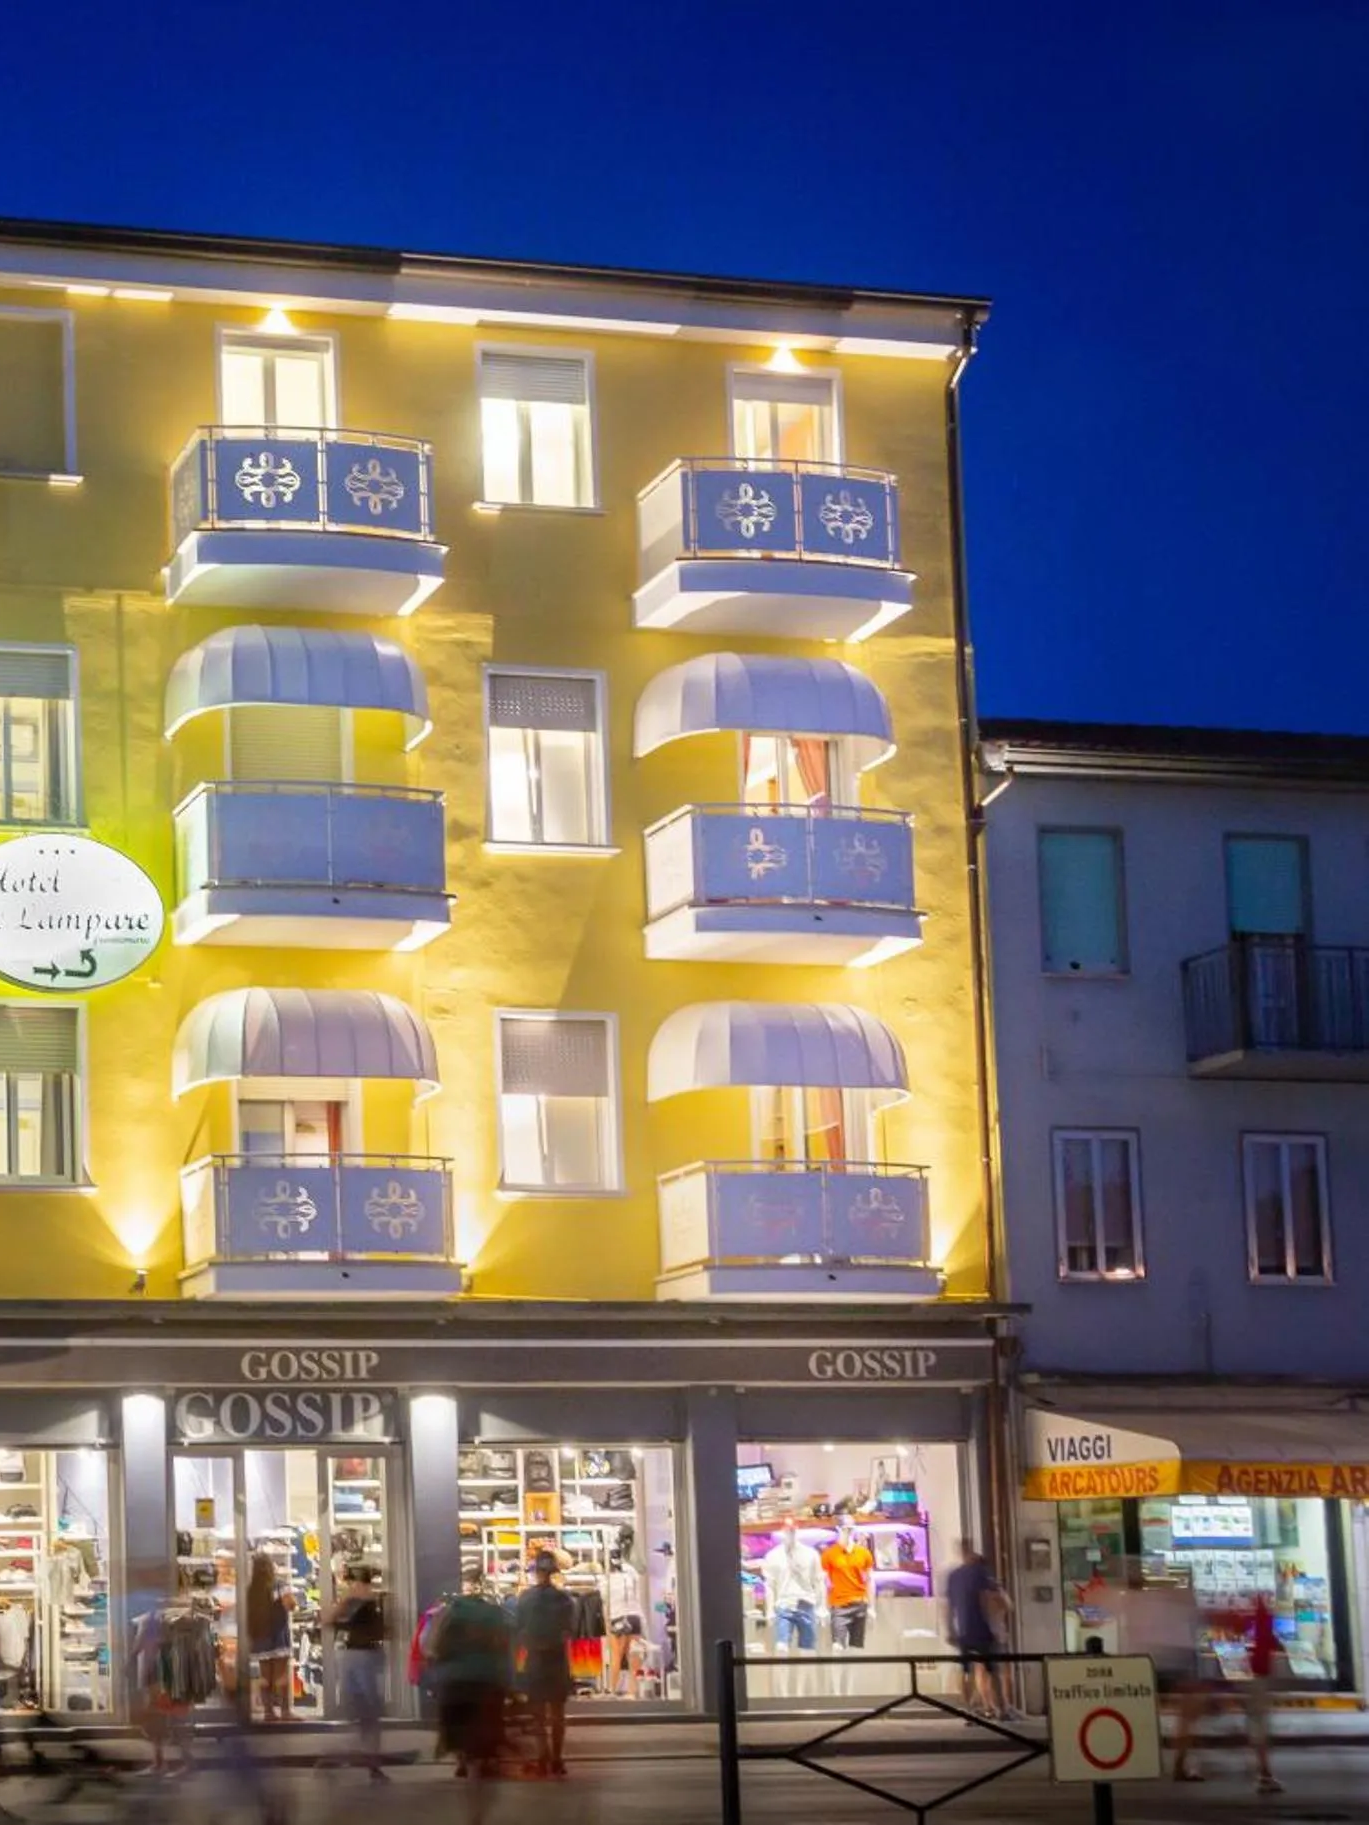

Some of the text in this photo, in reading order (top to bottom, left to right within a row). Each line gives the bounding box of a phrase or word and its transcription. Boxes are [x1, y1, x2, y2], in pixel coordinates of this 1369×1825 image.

[14, 905, 150, 939] Lampare
[241, 1350, 379, 1380] GOSSIP
[808, 1350, 937, 1379] GOSSIP
[176, 1392, 382, 1438] GOSSIP
[1047, 1434, 1111, 1461] VIAGGI
[1049, 1466, 1159, 1497] ARCATOURS
[1217, 1465, 1321, 1495] AGENZIA
[1053, 1681, 1151, 1699] traffico limitato
